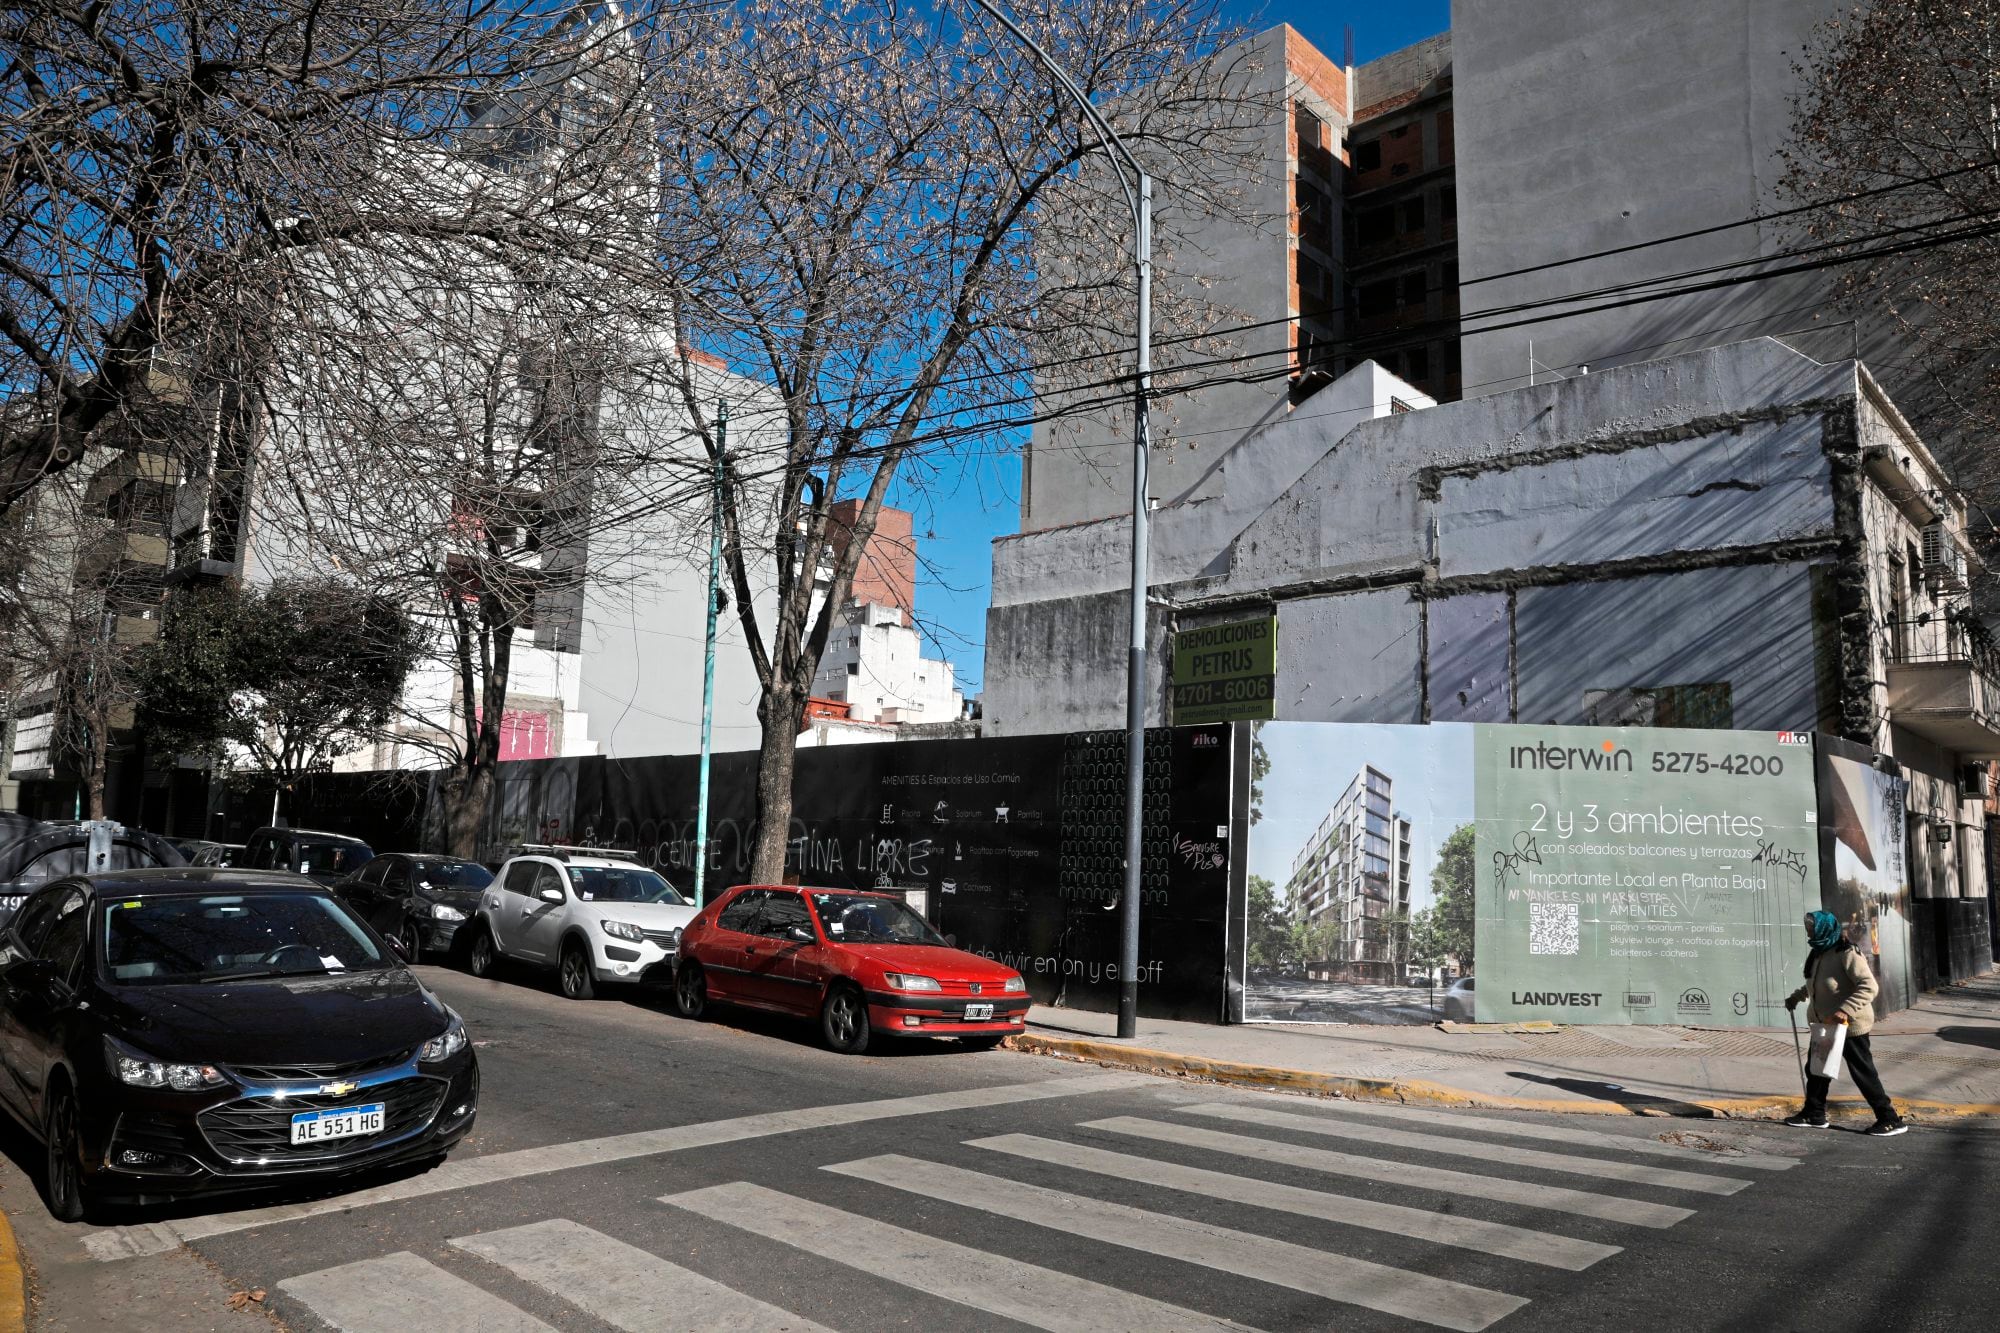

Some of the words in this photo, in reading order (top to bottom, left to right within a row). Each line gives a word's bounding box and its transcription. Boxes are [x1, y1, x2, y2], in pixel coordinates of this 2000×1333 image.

[1180, 621, 1268, 650] DEMOLICIONES
[1192, 648, 1253, 677] PETRUS
[1178, 683, 1212, 705] 4701
[1224, 678, 1268, 701] 6006
[1510, 740, 1633, 772] interwin
[1652, 751, 1784, 777] 5275-4200
[881, 774, 920, 785] AMENITIES
[920, 774, 927, 785] &
[928, 774, 962, 786] Espacios
[963, 774, 973, 785] de
[974, 774, 990, 785] Uso
[991, 772, 1021, 784] Común
[1530, 803, 1548, 832] 2
[1557, 810, 1573, 839] y
[1583, 804, 1599, 833] 3
[1608, 804, 1764, 837] ambientes
[1541, 844, 1565, 854] con
[1568, 842, 1625, 856] soleados
[1628, 843, 1687, 857] balcones
[1689, 847, 1698, 860] y
[1700, 845, 1753, 859] terrazas
[1529, 869, 1612, 888] Importante
[1615, 871, 1655, 887] Local
[1659, 875, 1678, 887] en
[1682, 873, 1728, 889] Planta
[1732, 873, 1767, 892] Baja
[1508, 889, 1520, 901] NI
[1586, 891, 1597, 904] NI
[1609, 904, 1678, 917] AMENITIES
[1610, 924, 1639, 934] piscina
[1647, 923, 1684, 932] solarium
[1691, 925, 1725, 934] parrillas
[1610, 936, 1643, 946] skyview
[1644, 937, 1674, 946] lounge
[1681, 938, 1713, 947] rooftop
[1660, 950, 1699, 958] cocheras
[1034, 956, 1056, 973] en
[1062, 958, 1084, 976] on
[1089, 963, 1101, 984] y
[1511, 991, 1603, 1007] LANDVEST
[1685, 993, 1706, 1004] GSA
[297, 1122, 318, 1140] AE
[324, 1117, 354, 1136] 551
[360, 1113, 380, 1131] HG
